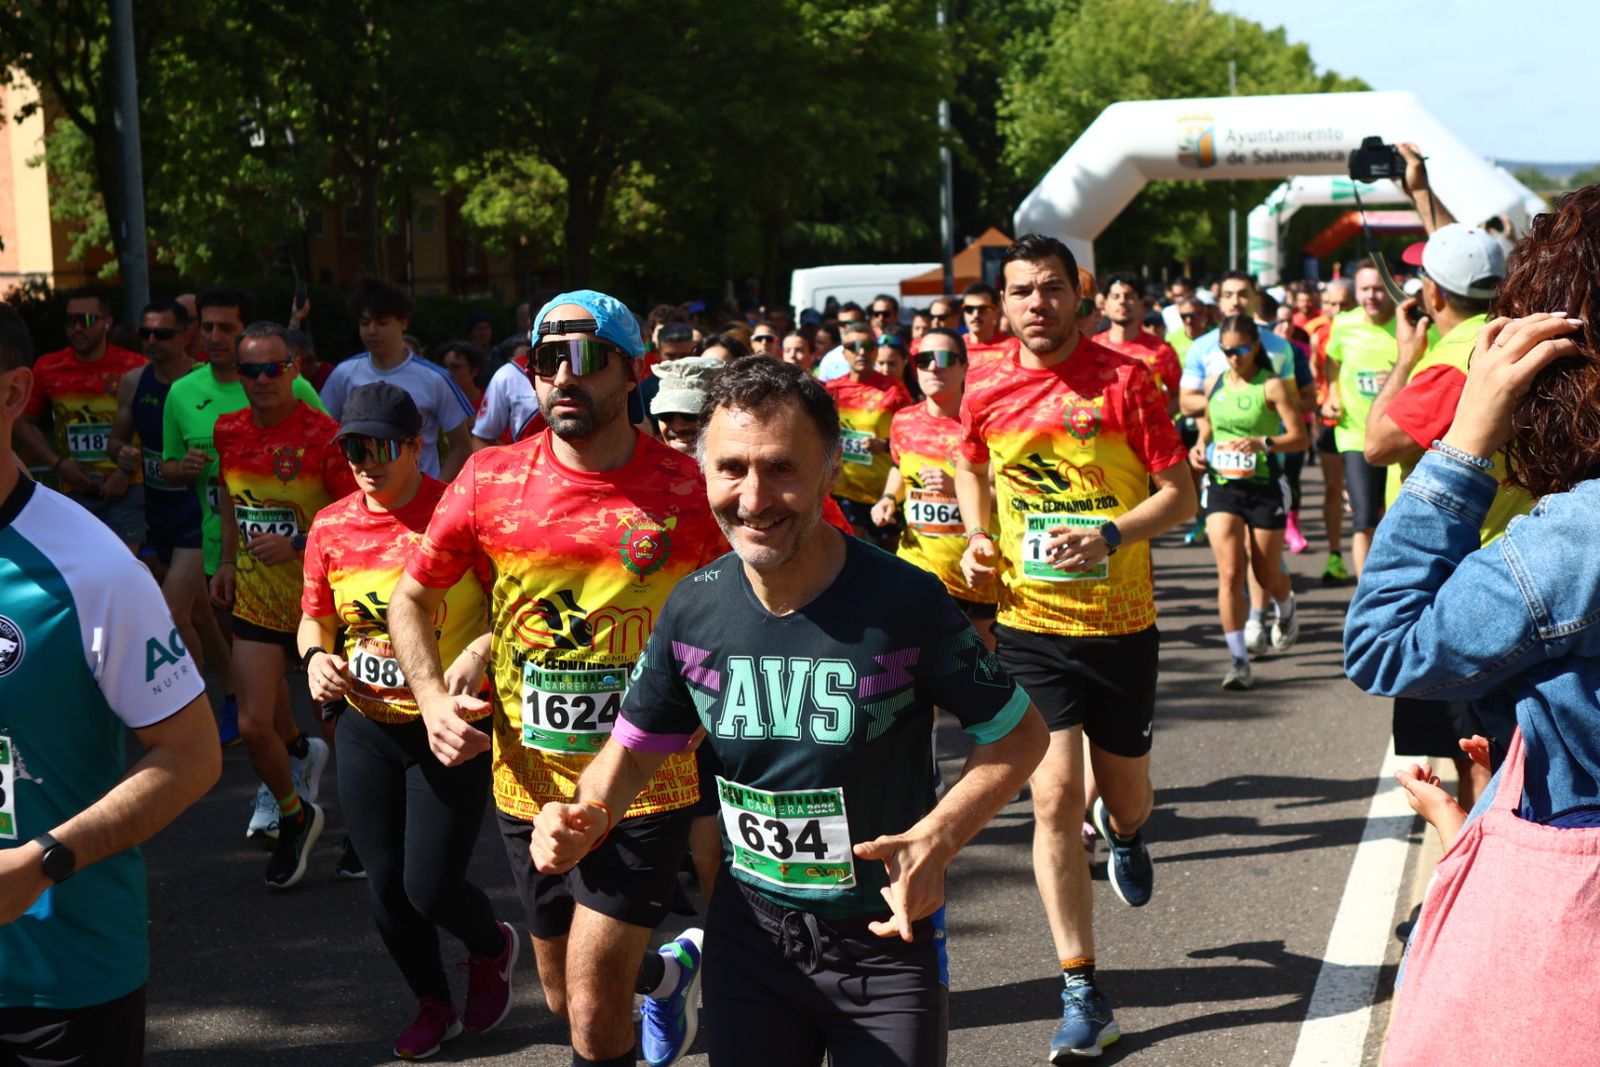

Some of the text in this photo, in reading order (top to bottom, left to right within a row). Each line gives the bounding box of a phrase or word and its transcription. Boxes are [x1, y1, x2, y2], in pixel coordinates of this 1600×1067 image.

[1226, 127, 1344, 145] Ayuntamiento
[1227, 149, 1345, 165] de Salamanca
[1217, 454, 1253, 468] 1715
[911, 502, 963, 523] 1964
[353, 652, 410, 688] 198
[545, 682, 597, 691] CARRERA
[716, 655, 858, 746] AVS
[526, 690, 620, 731] 1624
[746, 798, 805, 816] CARRERA
[738, 812, 829, 860] 634
